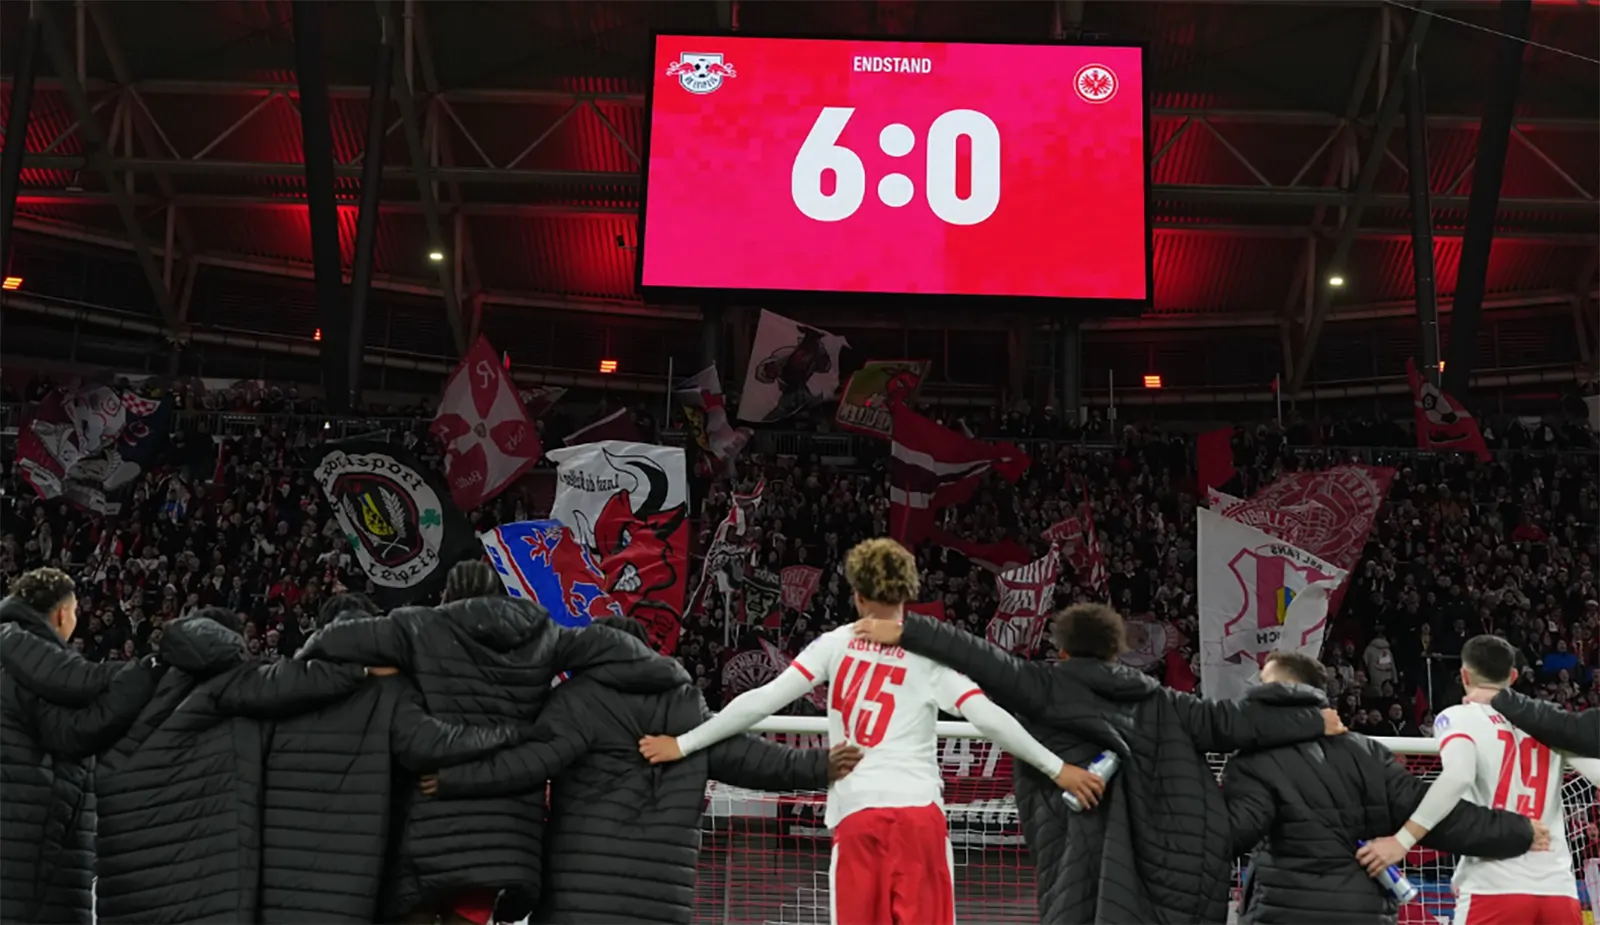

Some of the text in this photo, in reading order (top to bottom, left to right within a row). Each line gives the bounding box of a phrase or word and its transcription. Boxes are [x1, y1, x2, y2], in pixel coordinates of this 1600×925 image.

[853, 56, 931, 73] ENDSTAND
[791, 106, 1001, 226] 6:0
[831, 655, 907, 748] 45
